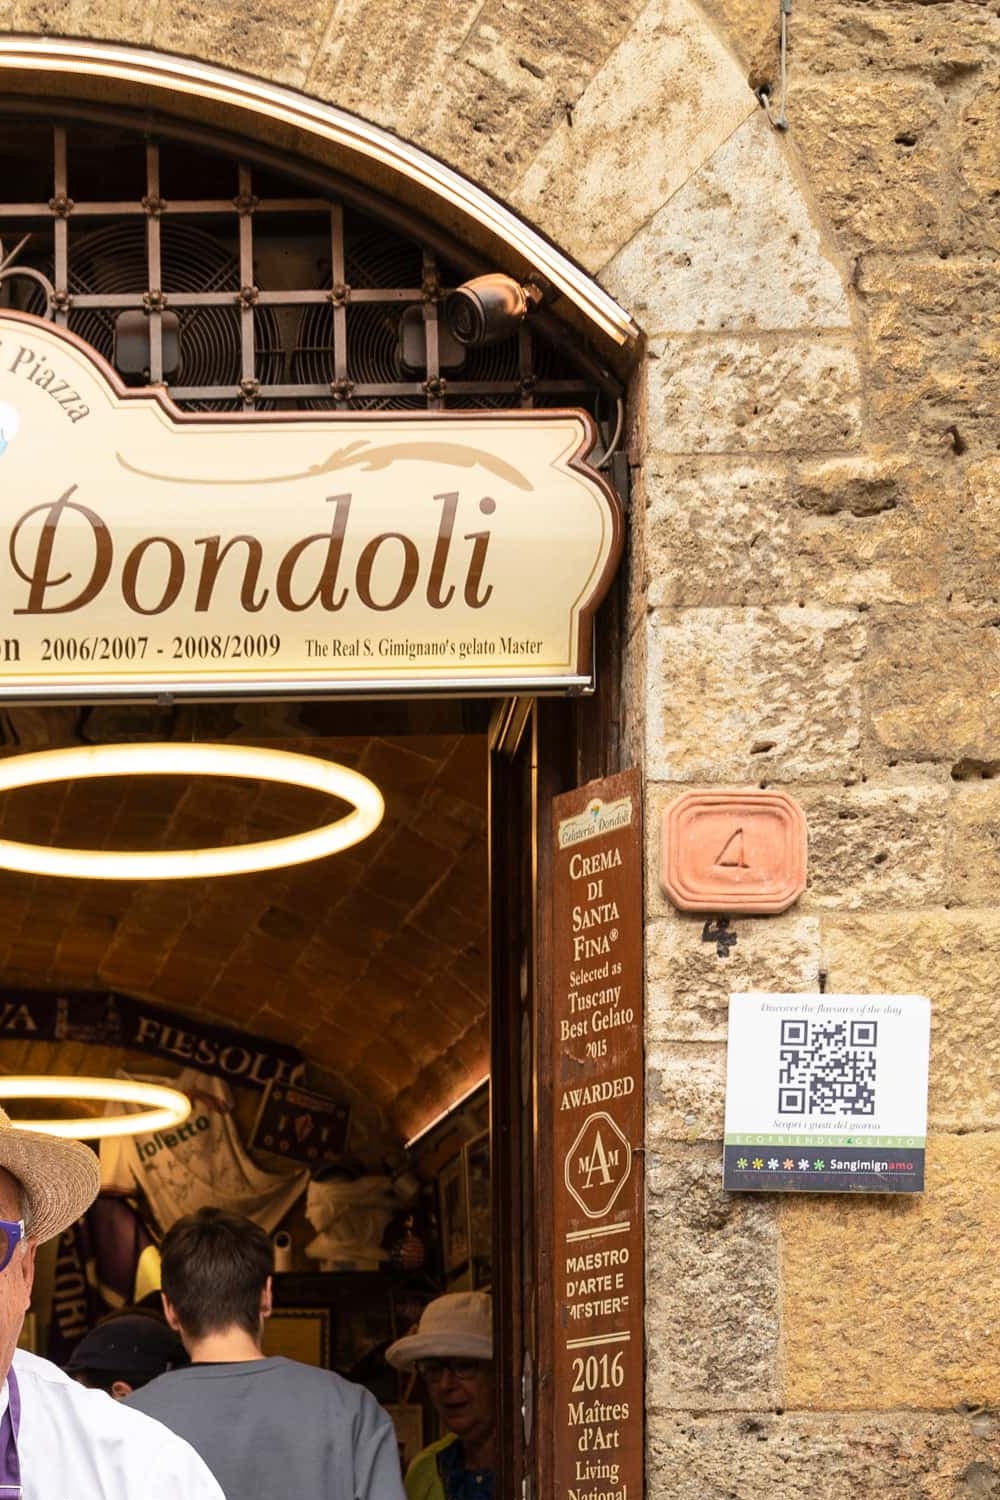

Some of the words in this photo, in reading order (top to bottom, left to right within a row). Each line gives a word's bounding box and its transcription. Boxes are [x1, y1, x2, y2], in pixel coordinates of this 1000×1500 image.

[8, 345, 91, 425] Piazza
[8, 483, 498, 616] Dondoli
[40, 635, 149, 662] 2006/2007
[172, 634, 281, 660] 2008/2009
[305, 639, 329, 657] The
[332, 639, 359, 657] Real
[363, 638, 374, 657] S.
[378, 638, 456, 661] Gimignano's
[459, 637, 495, 660] gelato
[499, 636, 544, 655] Master
[569, 848, 623, 880] CREMA
[587, 880, 603, 901] DI
[572, 902, 620, 933] SANTA
[569, 963, 609, 988] Selected
[611, 961, 622, 975] as
[568, 985, 622, 1014] Tuscany
[560, 1019, 588, 1041] Best
[592, 1007, 634, 1033] Gelato
[585, 1039, 608, 1058] 2015
[560, 1075, 635, 1111] AWARDED
[566, 1248, 629, 1273] MAESTRO
[567, 1275, 612, 1297] D'ARTE
[615, 1273, 624, 1289] E
[571, 1352, 625, 1393] 2016
[567, 1400, 630, 1426] Maîtres
[575, 1460, 620, 1484] Living
